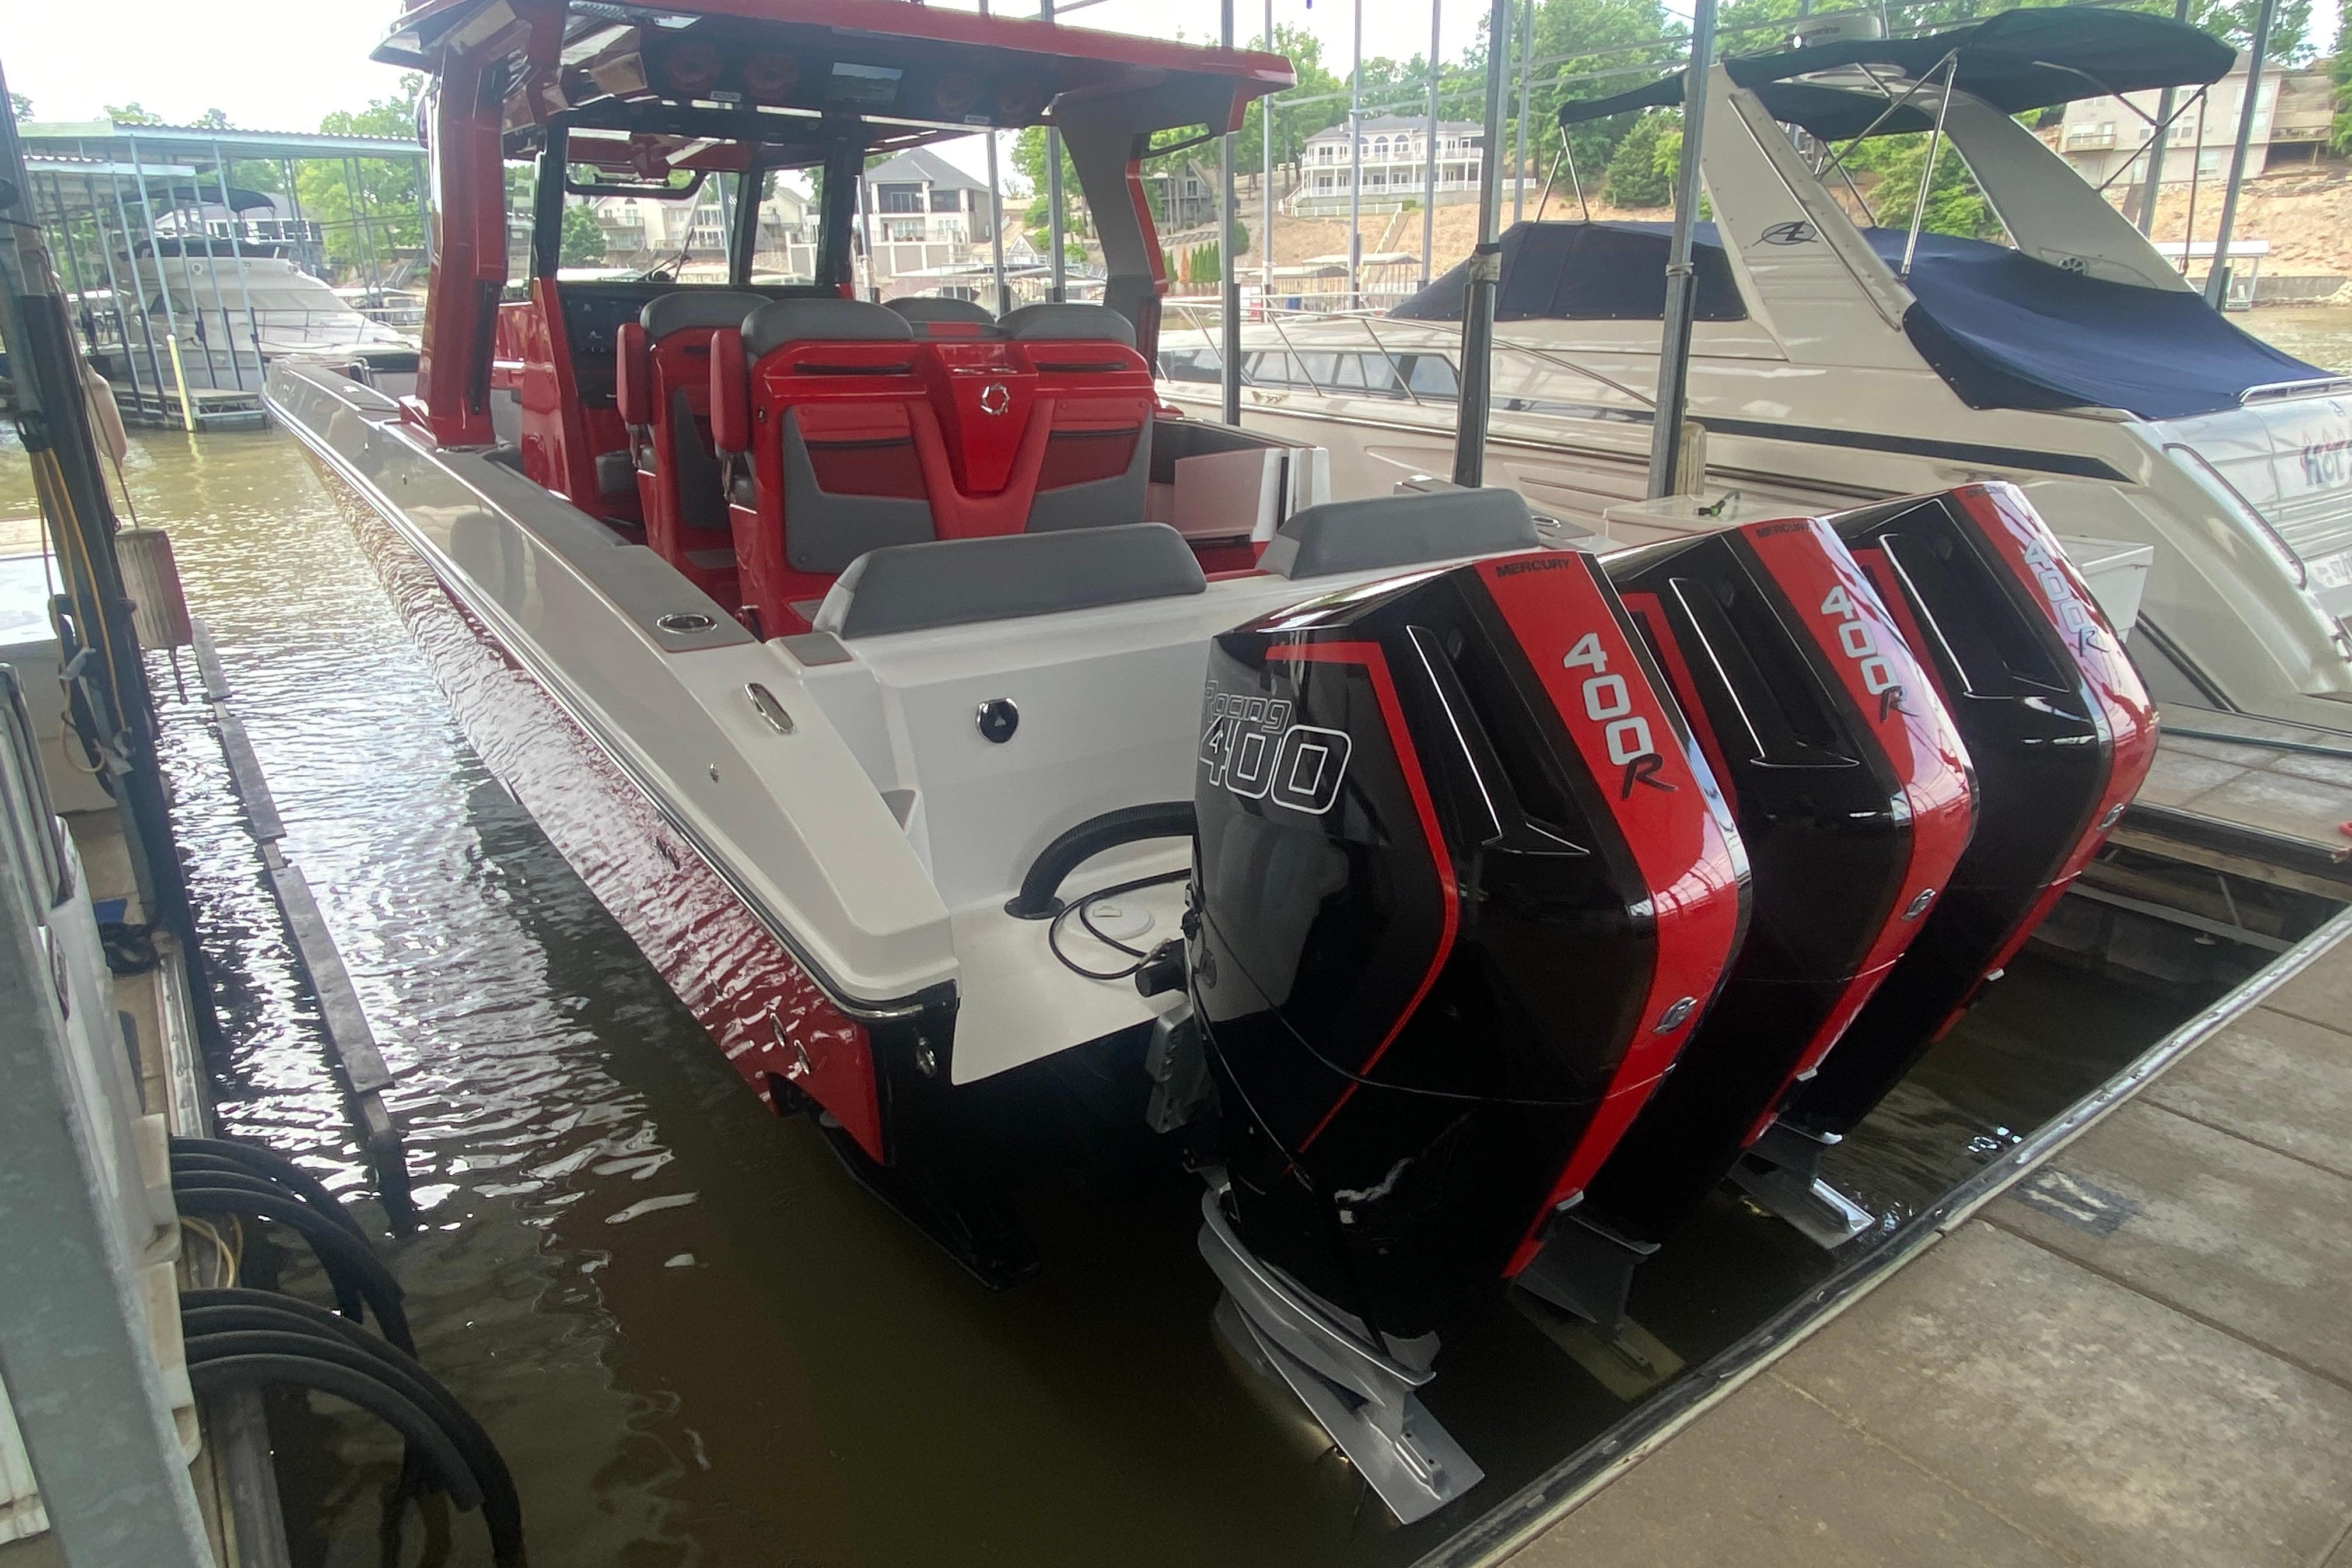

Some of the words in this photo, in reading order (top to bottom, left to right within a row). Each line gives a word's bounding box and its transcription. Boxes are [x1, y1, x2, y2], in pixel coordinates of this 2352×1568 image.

[1756, 522, 1811, 538] MERCURY
[1495, 558, 1570, 578] MERCURY
[1202, 680, 1292, 734] Racing
[1199, 715, 1352, 815] 400
